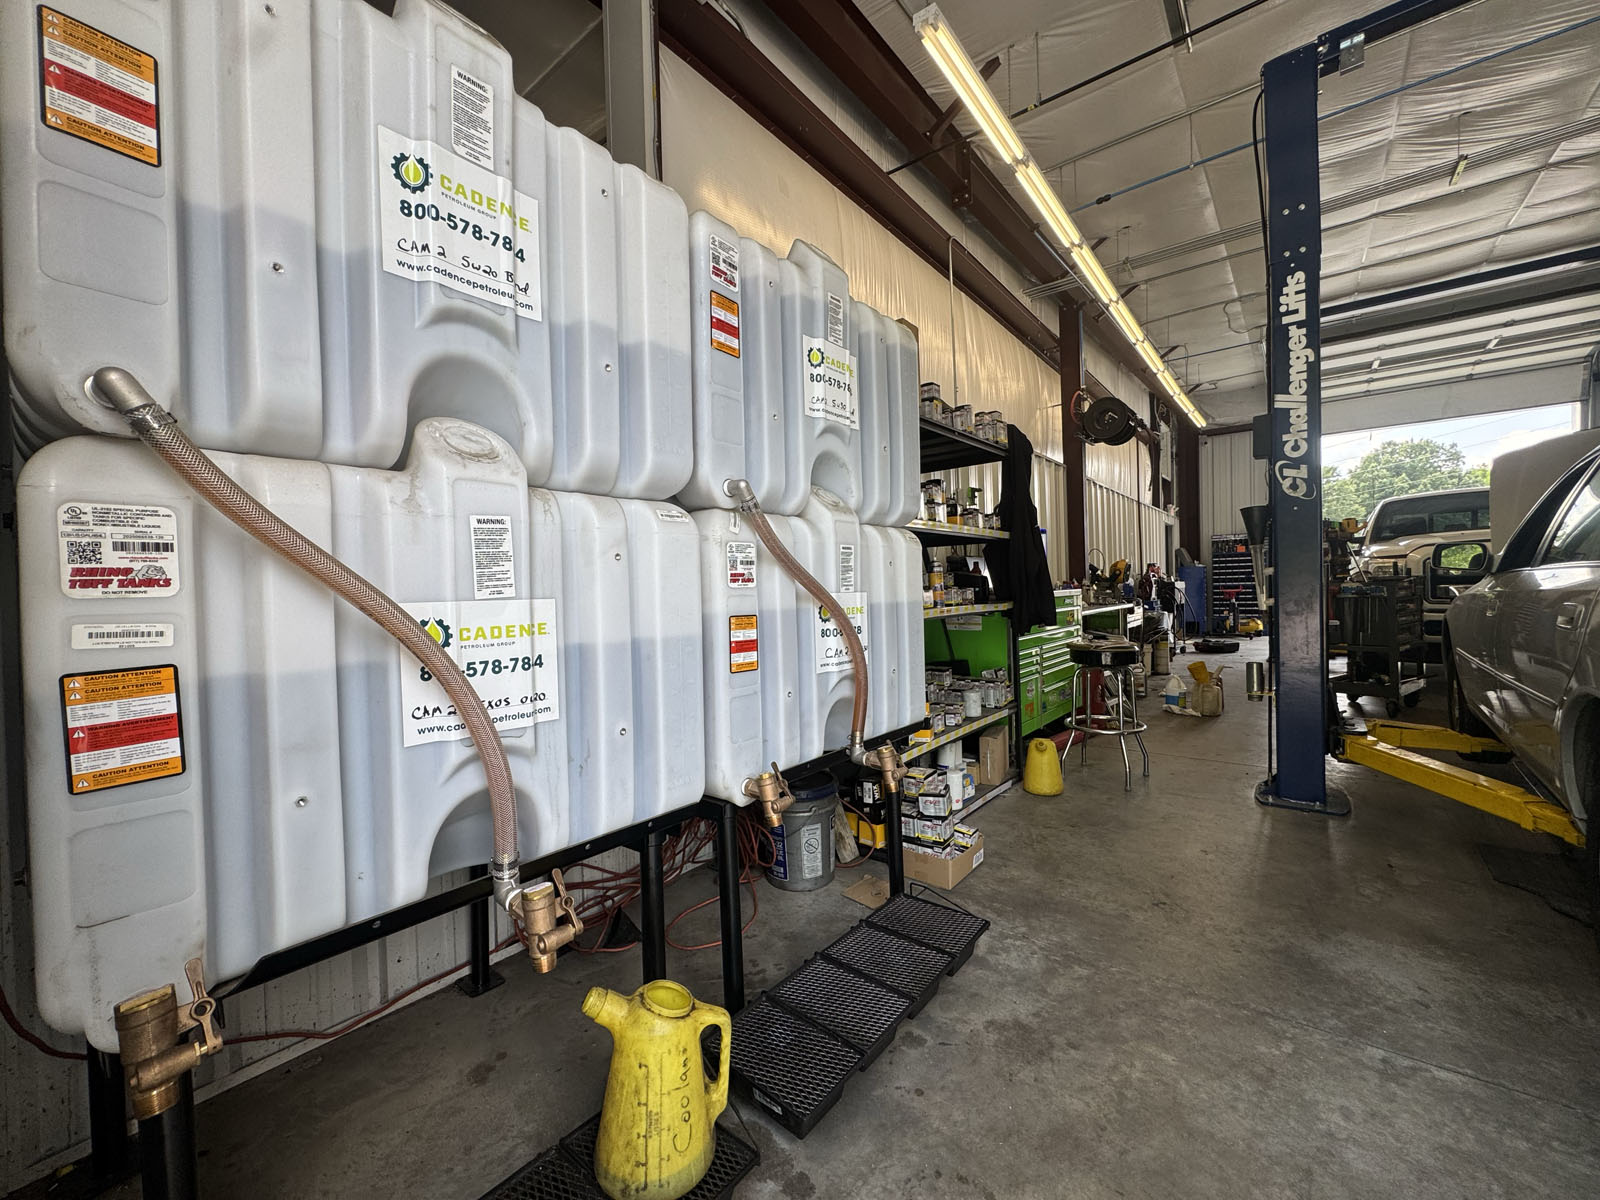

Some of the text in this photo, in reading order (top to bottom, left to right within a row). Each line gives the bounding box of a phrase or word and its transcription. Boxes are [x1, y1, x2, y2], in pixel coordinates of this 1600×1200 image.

[62, 18, 98, 37] CAUTION
[100, 36, 142, 57] ATTENTION
[62, 30, 98, 48] CAUTION
[100, 48, 142, 69] ATTENTION
[66, 116, 101, 133] CAUTION
[104, 131, 144, 150] ATTENTION
[441, 192, 497, 219] PETROLEUM GROUP
[397, 238, 430, 253] CAM
[437, 246, 447, 258] 2
[1279, 270, 1306, 324] Lifts
[1274, 326, 1315, 458] Challenger
[70, 567, 134, 577] RHINO
[69, 578, 172, 589] TUFF TANKS
[460, 642, 495, 650] PETROLEUM
[84, 670, 161, 682] CAUTION ATTENTION
[85, 681, 162, 694] CAUTION ATTENTION
[412, 705, 442, 720] CAM
[447, 705, 457, 716] 2
[92, 761, 169, 778] CAUTION ATTENTION
